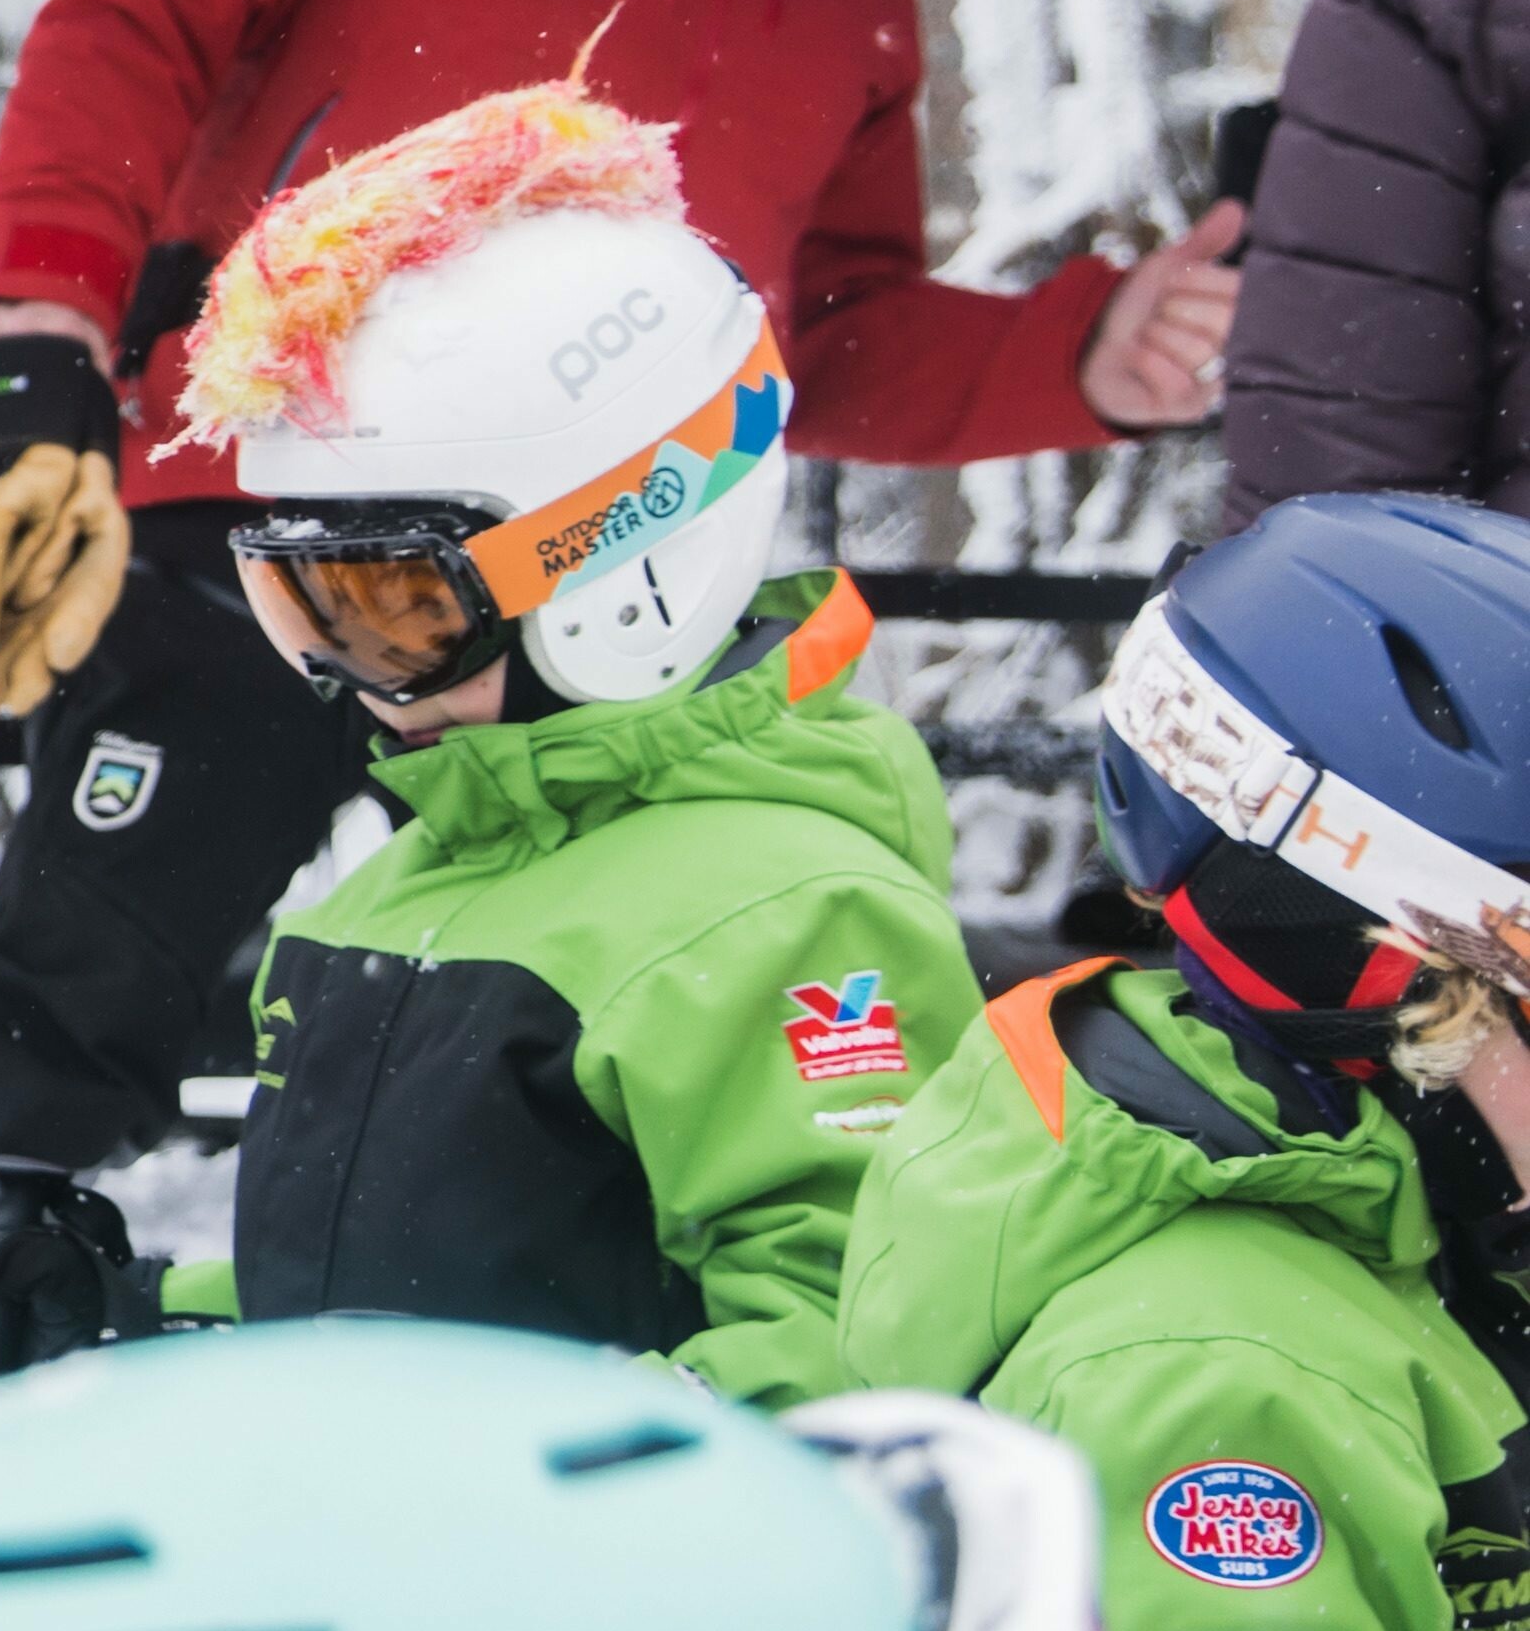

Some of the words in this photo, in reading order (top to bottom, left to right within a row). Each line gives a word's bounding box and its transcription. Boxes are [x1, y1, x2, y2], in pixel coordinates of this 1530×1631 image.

[536, 496, 634, 556] OUTDOOR
[543, 511, 644, 577] MASTER
[1170, 1483, 1301, 1531] Jersey
[1182, 1519, 1303, 1559] Mike's
[1218, 1560, 1269, 1577] SUBS
